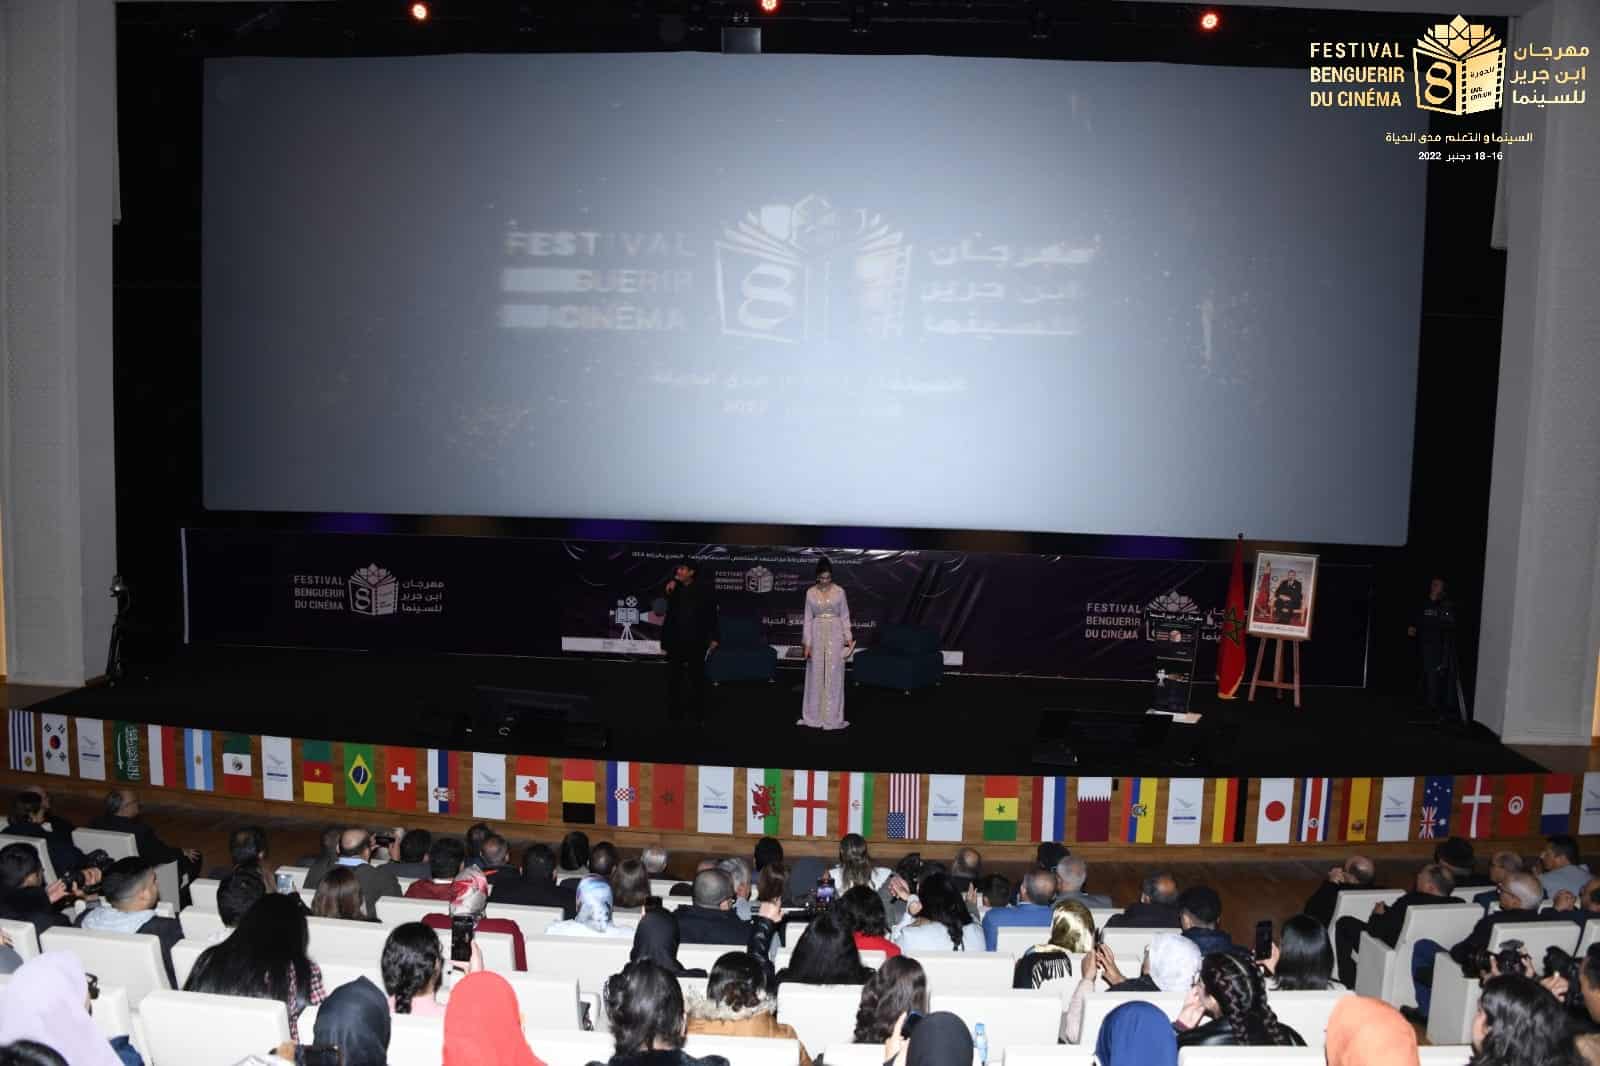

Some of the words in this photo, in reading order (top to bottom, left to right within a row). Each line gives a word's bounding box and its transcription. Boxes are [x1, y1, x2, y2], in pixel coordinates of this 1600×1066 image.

[503, 231, 697, 257] FESTIVAL
[294, 575, 344, 586] FESTIVAL
[402, 579, 445, 589] مهرجان
[295, 600, 308, 610] DU
[355, 588, 370, 610] 8
[1086, 602, 1142, 614] FESTIVAL
[1086, 615, 1142, 627] BENGUERIR
[1085, 628, 1101, 639] DU
[1101, 626, 1139, 640] CINÉMA
